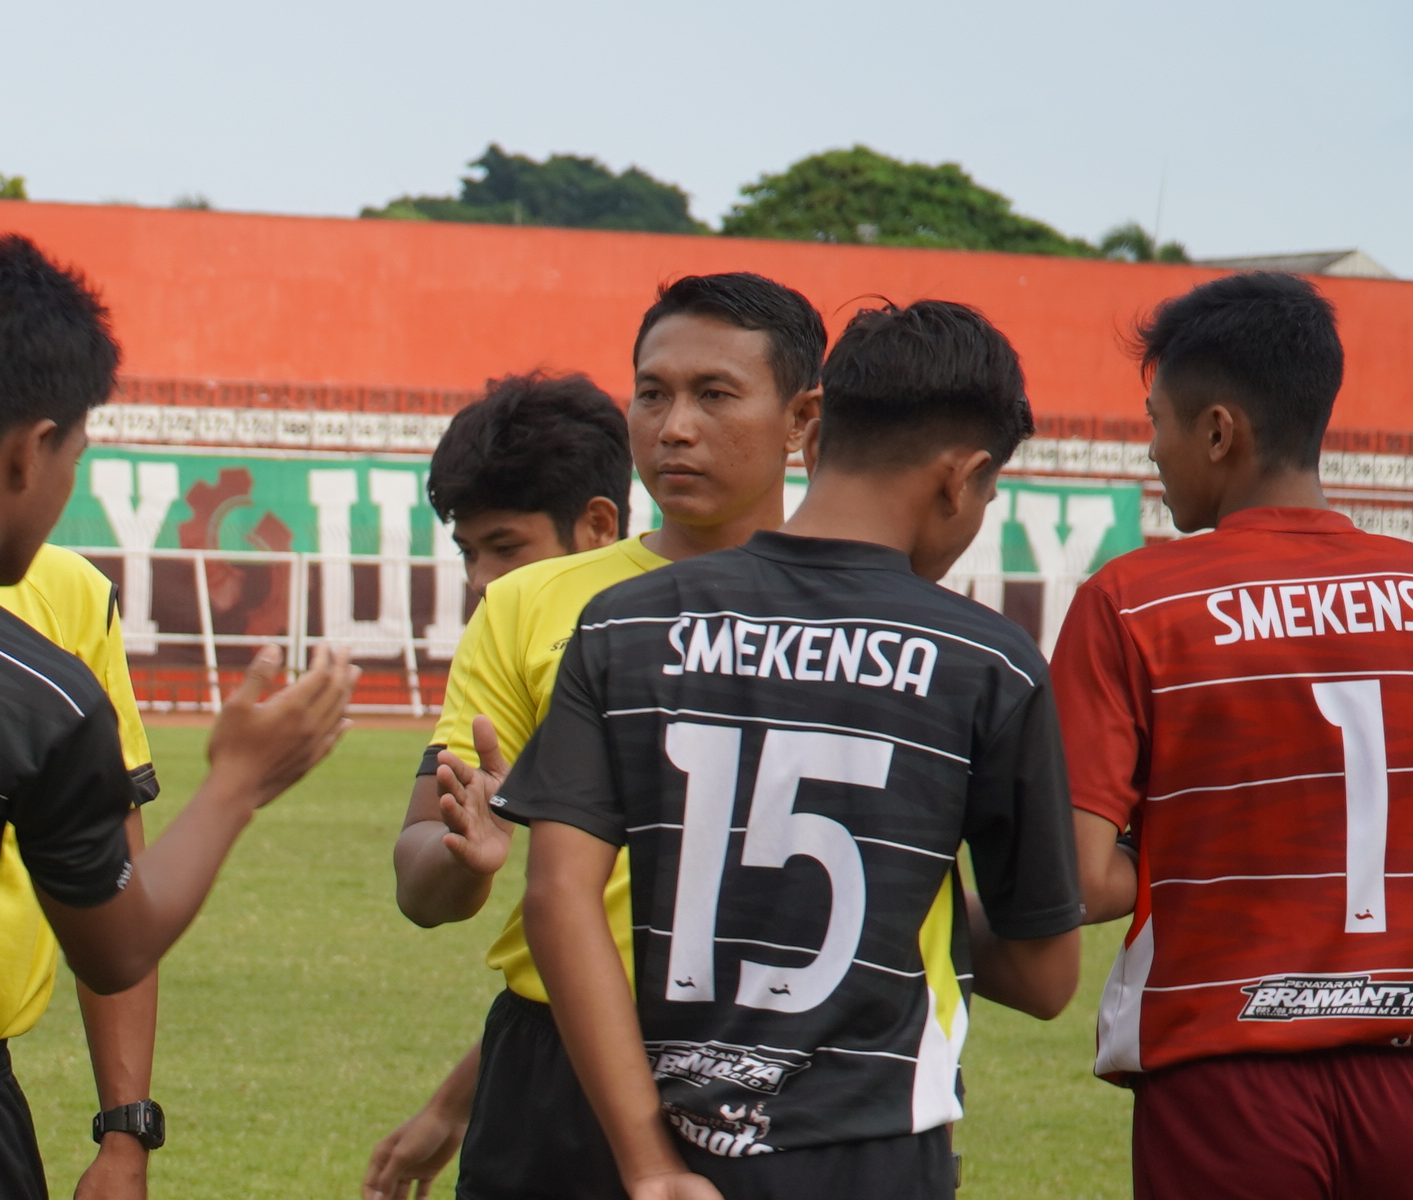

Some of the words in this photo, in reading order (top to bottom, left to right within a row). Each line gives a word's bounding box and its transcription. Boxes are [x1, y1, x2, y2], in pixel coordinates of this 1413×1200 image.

[662, 617, 939, 698] SMEKENSA
[664, 722, 895, 1014] 15
[1311, 679, 1388, 934] 1
[1284, 979, 1364, 990] PENATARAN
